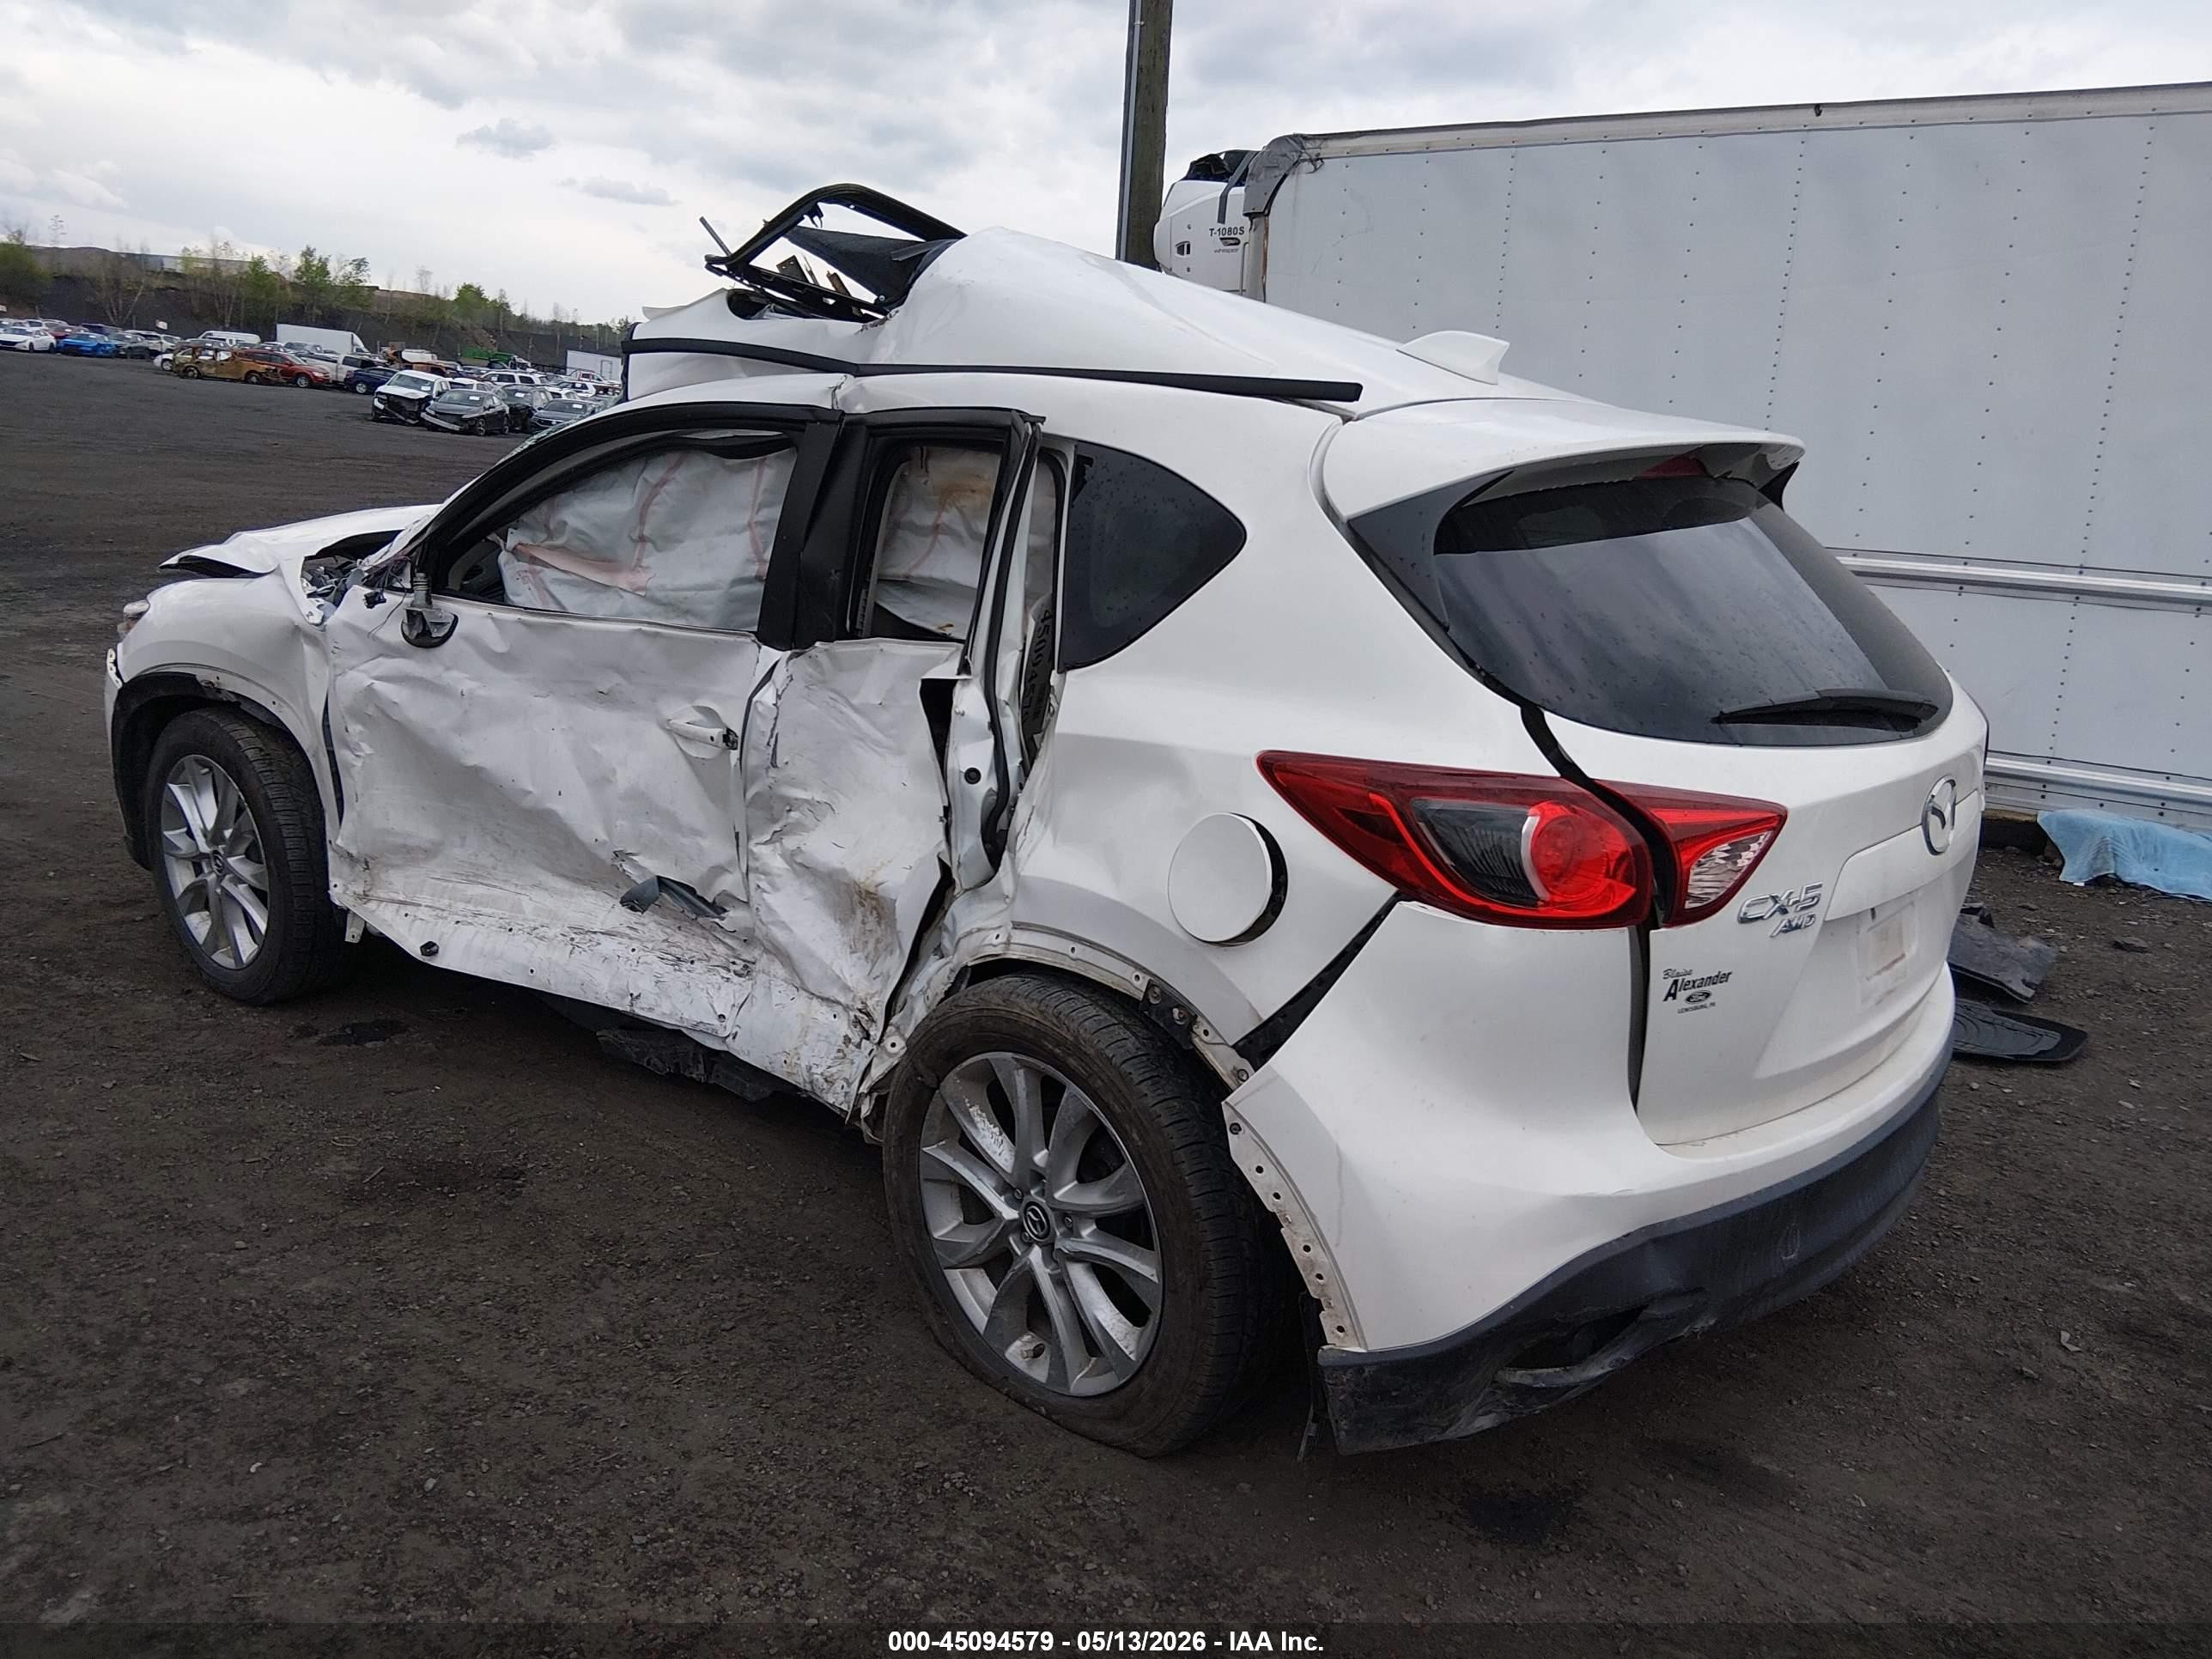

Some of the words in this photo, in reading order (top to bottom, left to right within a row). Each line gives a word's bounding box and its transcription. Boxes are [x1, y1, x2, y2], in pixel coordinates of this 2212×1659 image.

[1208, 226, 1245, 237] T-1080S
[1737, 881, 1824, 925] CX-5
[1769, 912, 1816, 939] AWD
[1662, 970, 1733, 1002] Alexander
